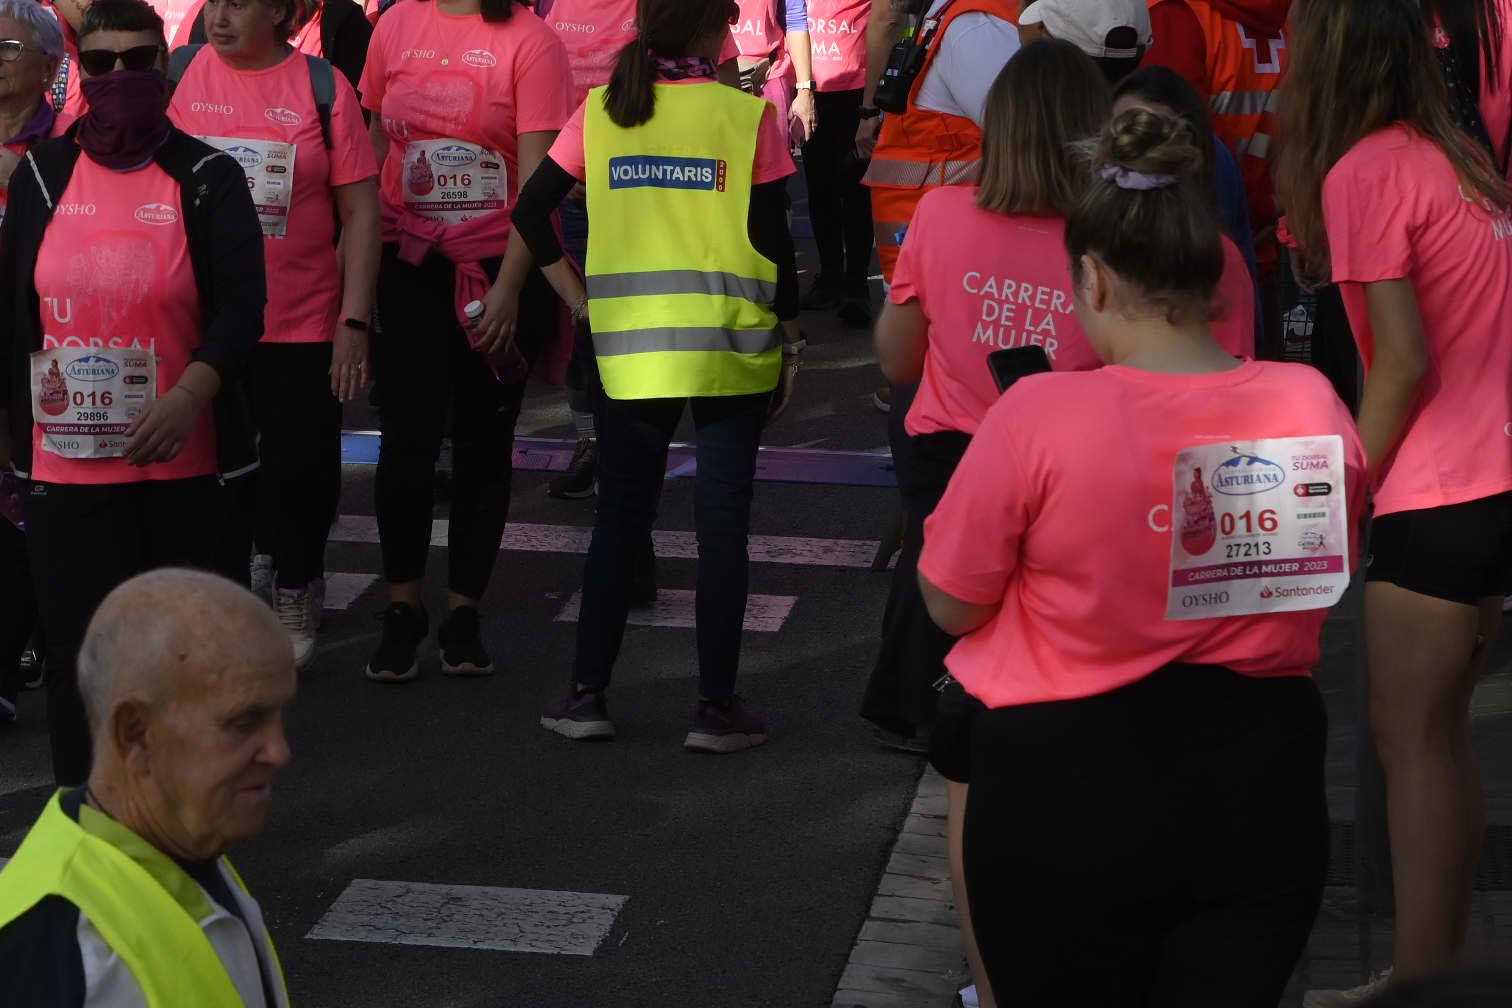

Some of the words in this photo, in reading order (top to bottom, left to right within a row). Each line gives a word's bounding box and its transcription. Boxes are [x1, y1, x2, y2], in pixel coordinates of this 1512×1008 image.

[555, 22, 595, 34] OYSHO
[192, 102, 233, 114] OYSHO
[436, 153, 474, 162] ASTURIANA
[611, 163, 713, 183] VOLUNTARIS
[438, 174, 472, 187] 016
[441, 191, 468, 199] 26598
[983, 301, 1014, 325] DE
[1025, 310, 1057, 336] LA
[70, 364, 116, 376] ASTURIANA
[73, 392, 113, 406] 016
[77, 412, 108, 421] 29896
[1292, 460, 1329, 471] SUMA
[1216, 472, 1279, 489] ASTURIANA
[1220, 509, 1279, 536] 016
[1225, 541, 1272, 558] 27213
[1188, 568, 1229, 581] CARRERA
[1229, 566, 1245, 576] DE
[1245, 565, 1260, 575] LA
[1262, 562, 1300, 574] MUJER
[1304, 560, 1328, 571] 2023
[1275, 585, 1335, 598] Santander
[1182, 591, 1230, 608] OYSHO
